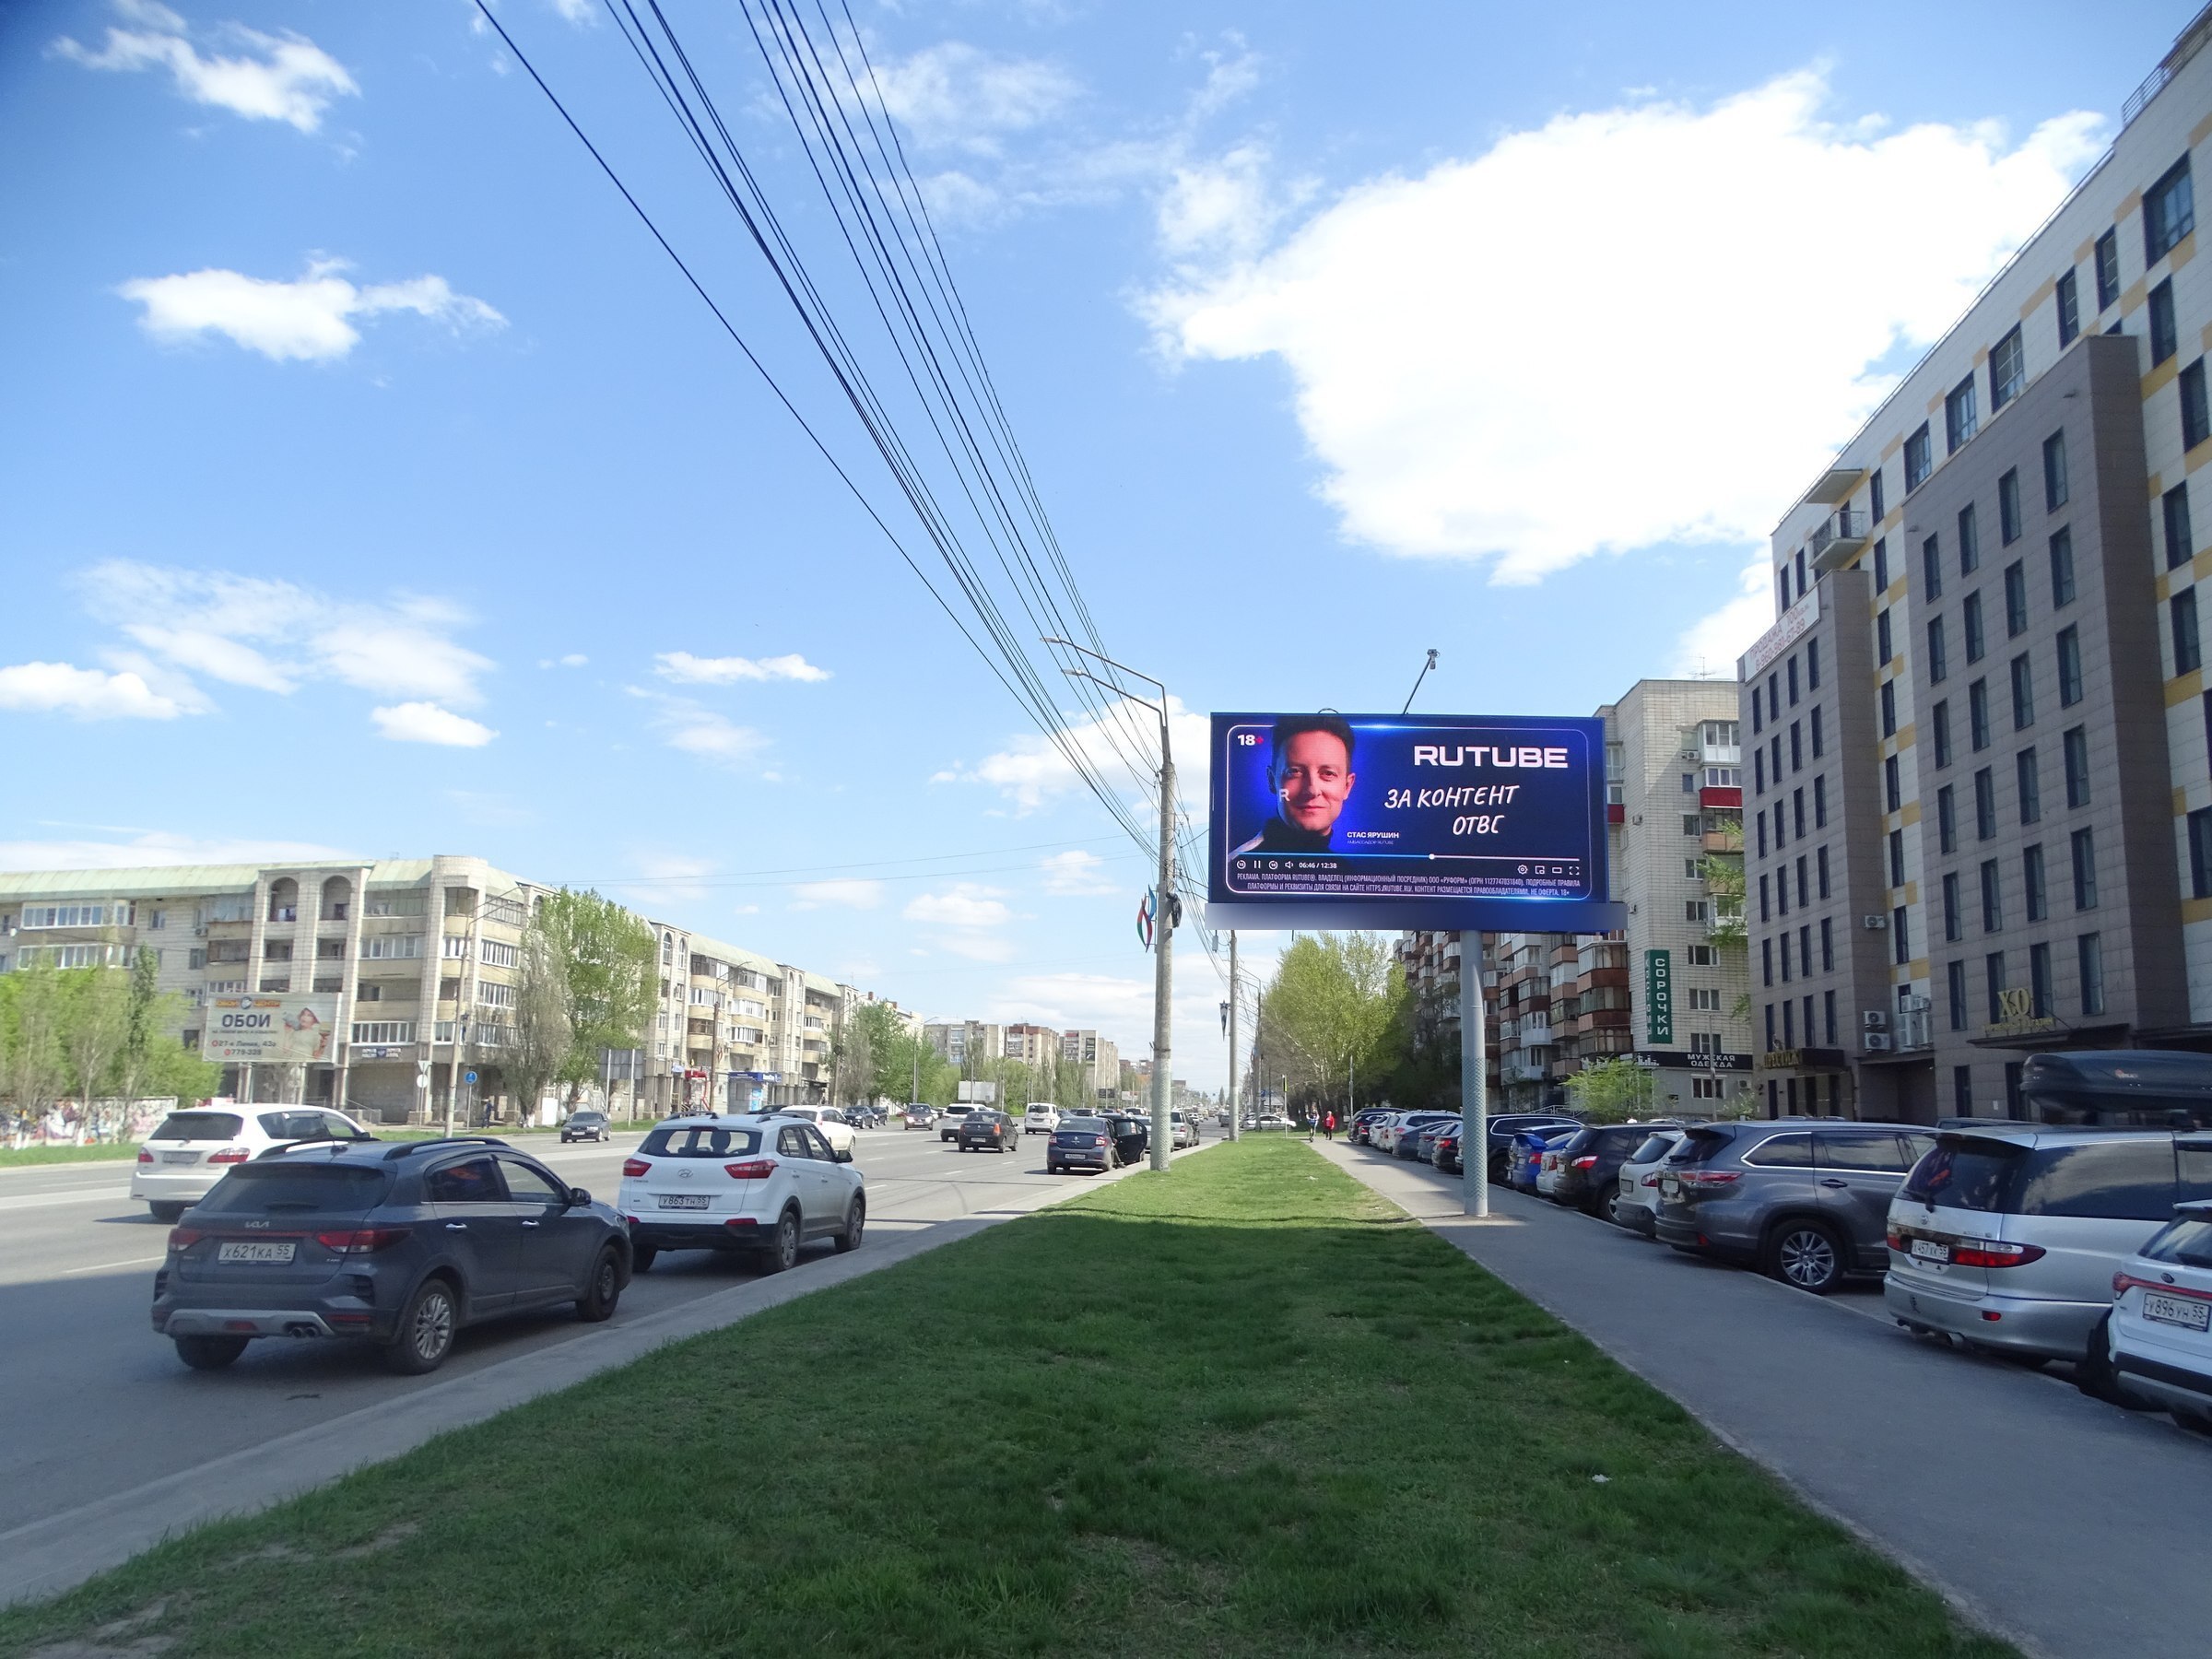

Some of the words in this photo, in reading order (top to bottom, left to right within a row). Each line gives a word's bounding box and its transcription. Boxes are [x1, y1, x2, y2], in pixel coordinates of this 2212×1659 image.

[1237, 734, 1264, 746] 18+
[1414, 745, 1569, 769] RUTUBE
[1384, 788, 1411, 809] ЗА
[1417, 784, 1520, 808] КОНТЕНТ
[1261, 873, 1291, 881] ПЛАТФОРМА
[1318, 874, 1344, 883] ВЛАДЕЛЕЦ
[1344, 874, 1395, 884] (ИНФОРМАЦИОННЫЙ
[1396, 876, 1428, 884] ПОСРЕДНИК)
[1429, 876, 1440, 884] ООО
[1525, 878, 1556, 887] ПОДРОБНЫЕ
[1313, 883, 1324, 891] ДЛЯ
[1324, 883, 1342, 891] СВЯЗИ
[1349, 883, 1365, 891] САЙТЕ
[1414, 885, 1436, 893] КОНТЕНТ
[1437, 886, 1472, 894] РАЗМЕЩАЕТСЯ
[1473, 887, 1529, 895] ПРАВООБЛАДАТЕЛЯМИ.
[1655, 958, 1669, 1035] СОРОЧКИ
[221, 1014, 270, 1028] ОБОИ
[698, 1195, 707, 1204] 55
[224, 1245, 272, 1259] Х621КА
[276, 1244, 289, 1255] 55
[2148, 1299, 2189, 1320] У896УН
[2193, 1305, 2205, 1319] 55
